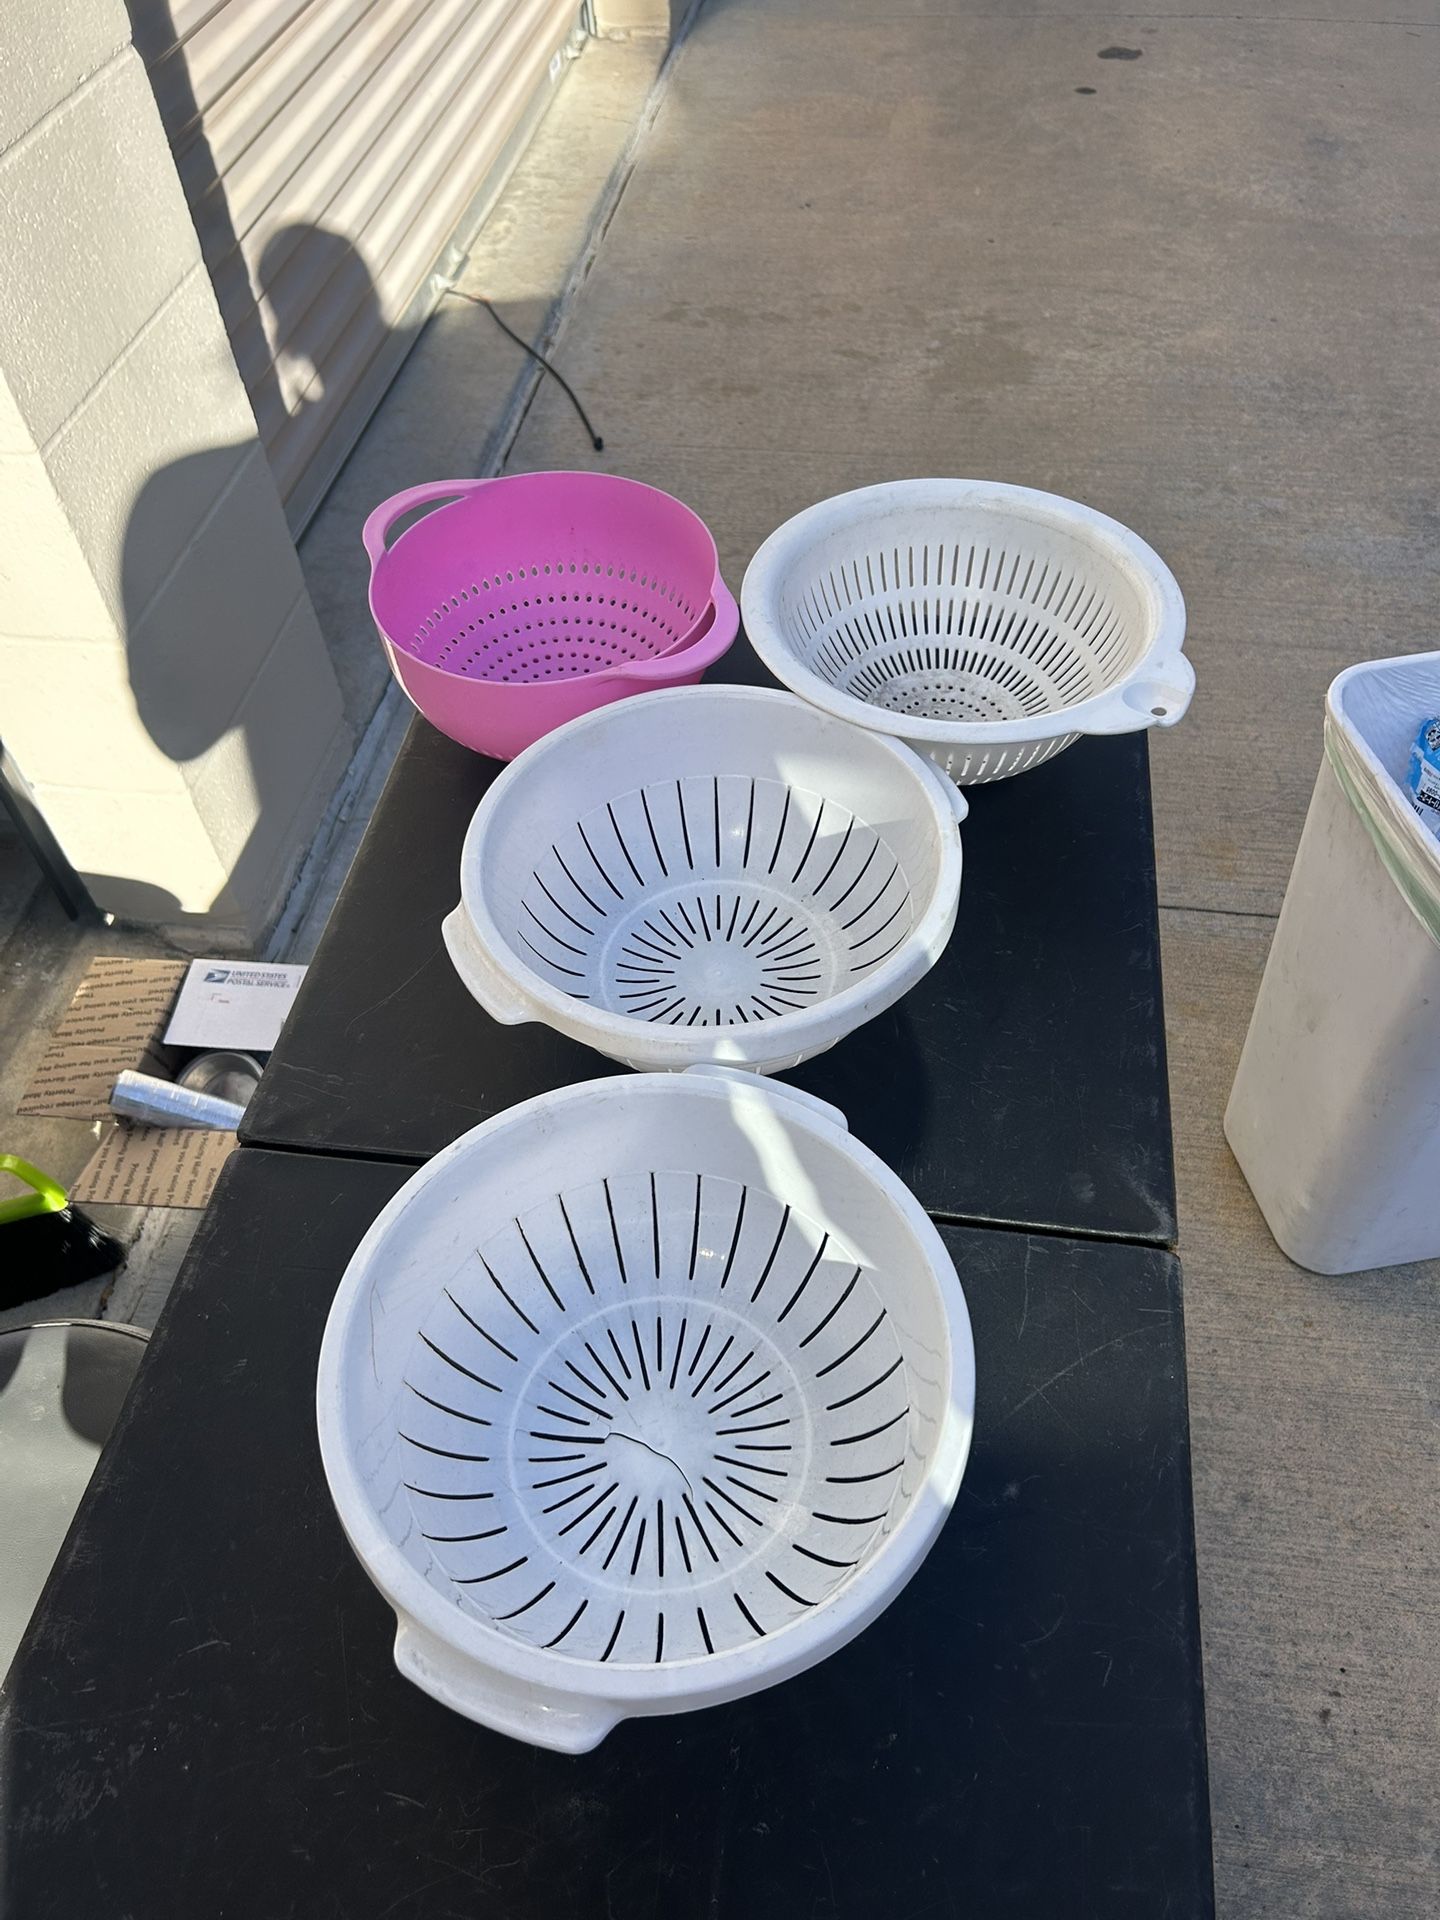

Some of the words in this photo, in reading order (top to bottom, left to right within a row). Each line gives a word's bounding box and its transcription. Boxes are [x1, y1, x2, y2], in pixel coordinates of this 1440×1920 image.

[16, 1104, 54, 1115] required
[124, 1163, 139, 1187] Priority
[104, 1175, 119, 1200] Service
[183, 1180, 196, 1204] Service
